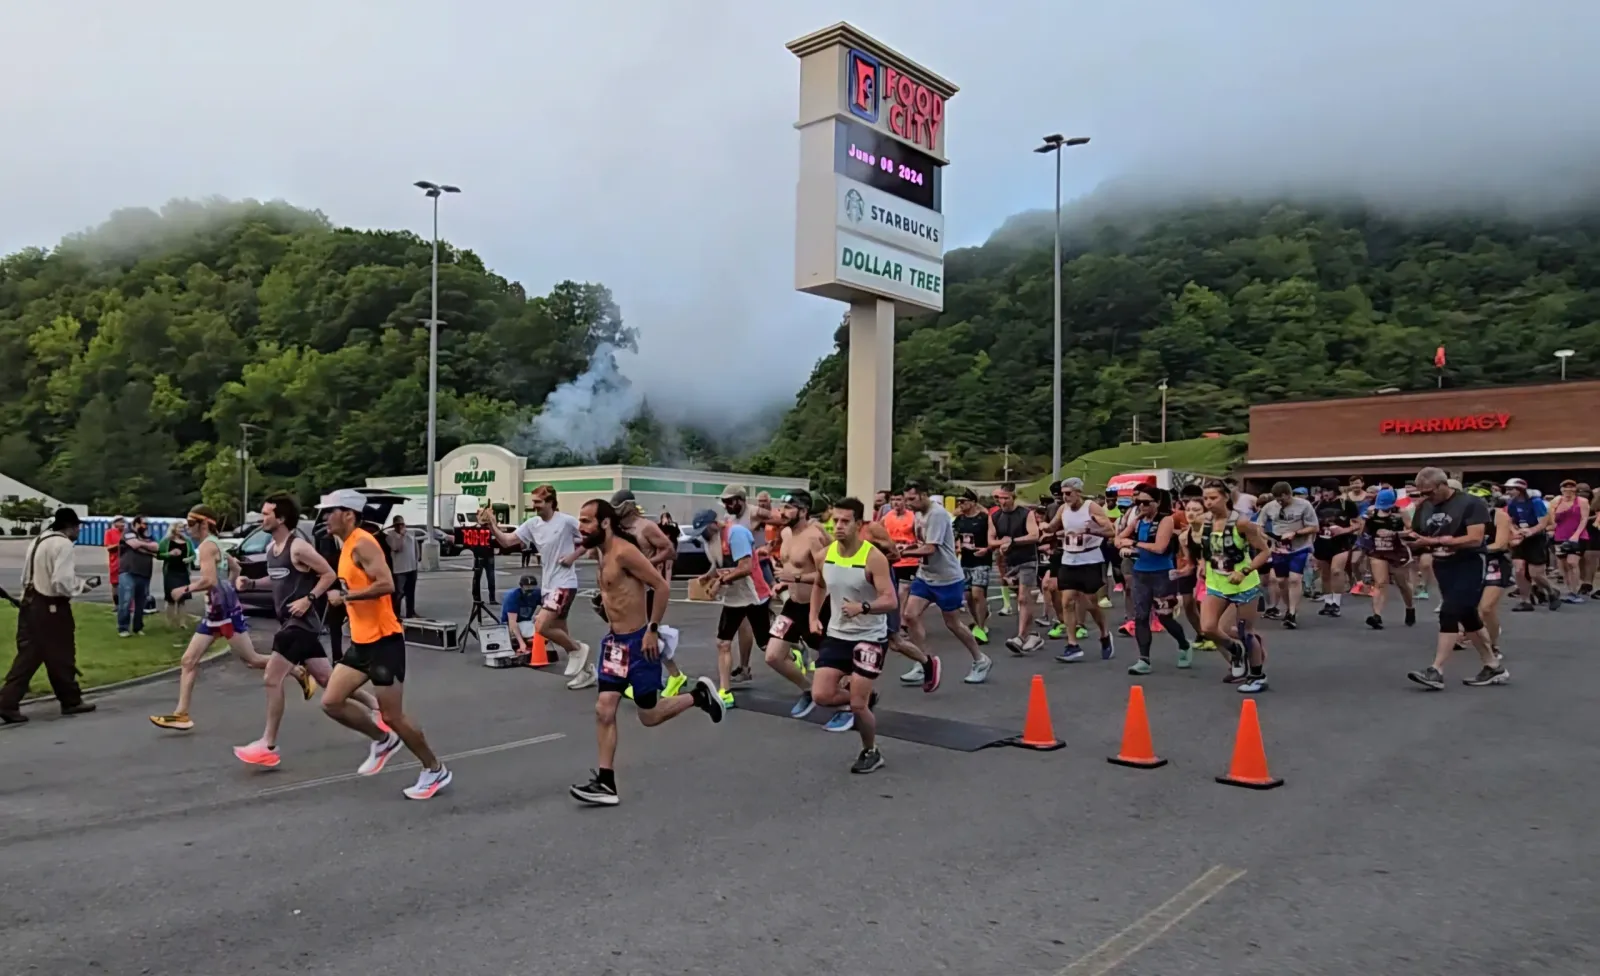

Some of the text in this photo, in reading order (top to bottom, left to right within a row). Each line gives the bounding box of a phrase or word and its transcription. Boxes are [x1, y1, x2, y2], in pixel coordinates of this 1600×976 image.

[884, 66, 944, 122] FOOD
[888, 104, 939, 150] CITY
[848, 143, 876, 166] June
[898, 164, 924, 186] 2024
[871, 205, 940, 242] STARBUCKS
[842, 247, 941, 293] DOLLAR TREE
[1379, 411, 1511, 434] PHARMACY
[454, 470, 496, 484] DOLLAR
[461, 484, 488, 497] TREE
